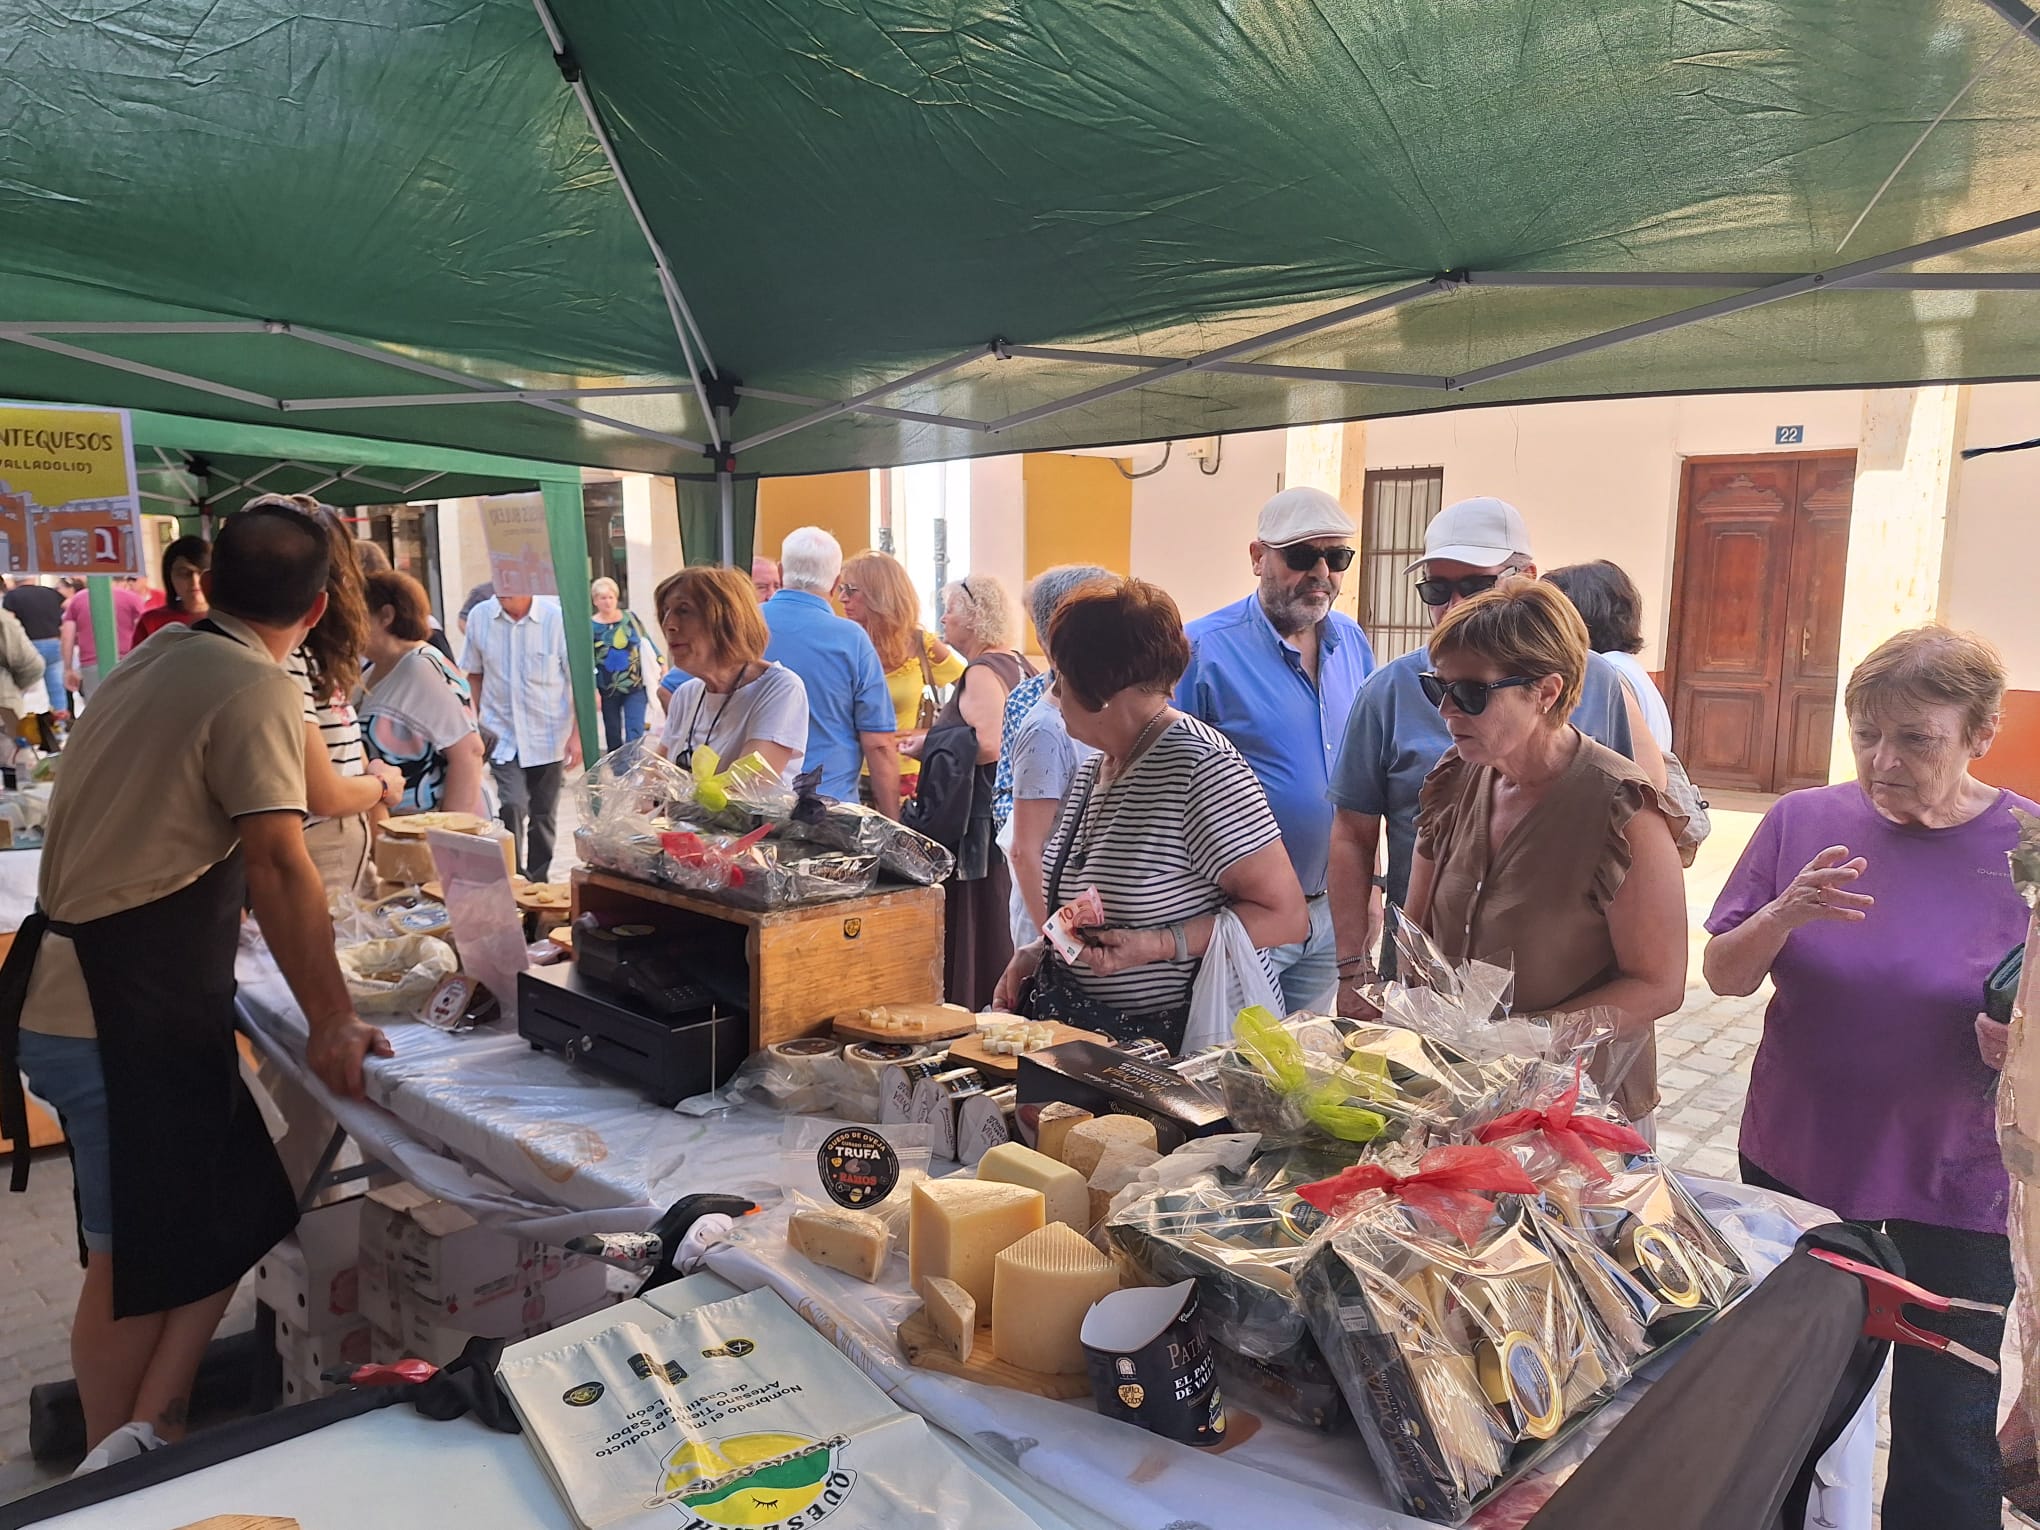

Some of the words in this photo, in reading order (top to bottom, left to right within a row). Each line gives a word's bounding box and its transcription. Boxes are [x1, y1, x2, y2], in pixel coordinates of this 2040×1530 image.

[1780, 428, 1798, 442] 22
[0, 459, 92, 474] ALLADOLID)
[1059, 907, 1074, 924] 10
[827, 1132, 850, 1150] QUESO
[863, 1134, 886, 1152] OVEJA
[835, 1146, 880, 1160] TRUFA
[732, 1383, 748, 1394] de
[1174, 1375, 1192, 1389] EL
[717, 1380, 780, 1407] Artesano
[727, 1384, 803, 1414] Nombrado
[1175, 1385, 1195, 1401] DE
[626, 1399, 665, 1421] León
[655, 1406, 673, 1420] de
[711, 1412, 725, 1425] el
[595, 1421, 667, 1458] producto
[604, 1419, 652, 1444] Sabor
